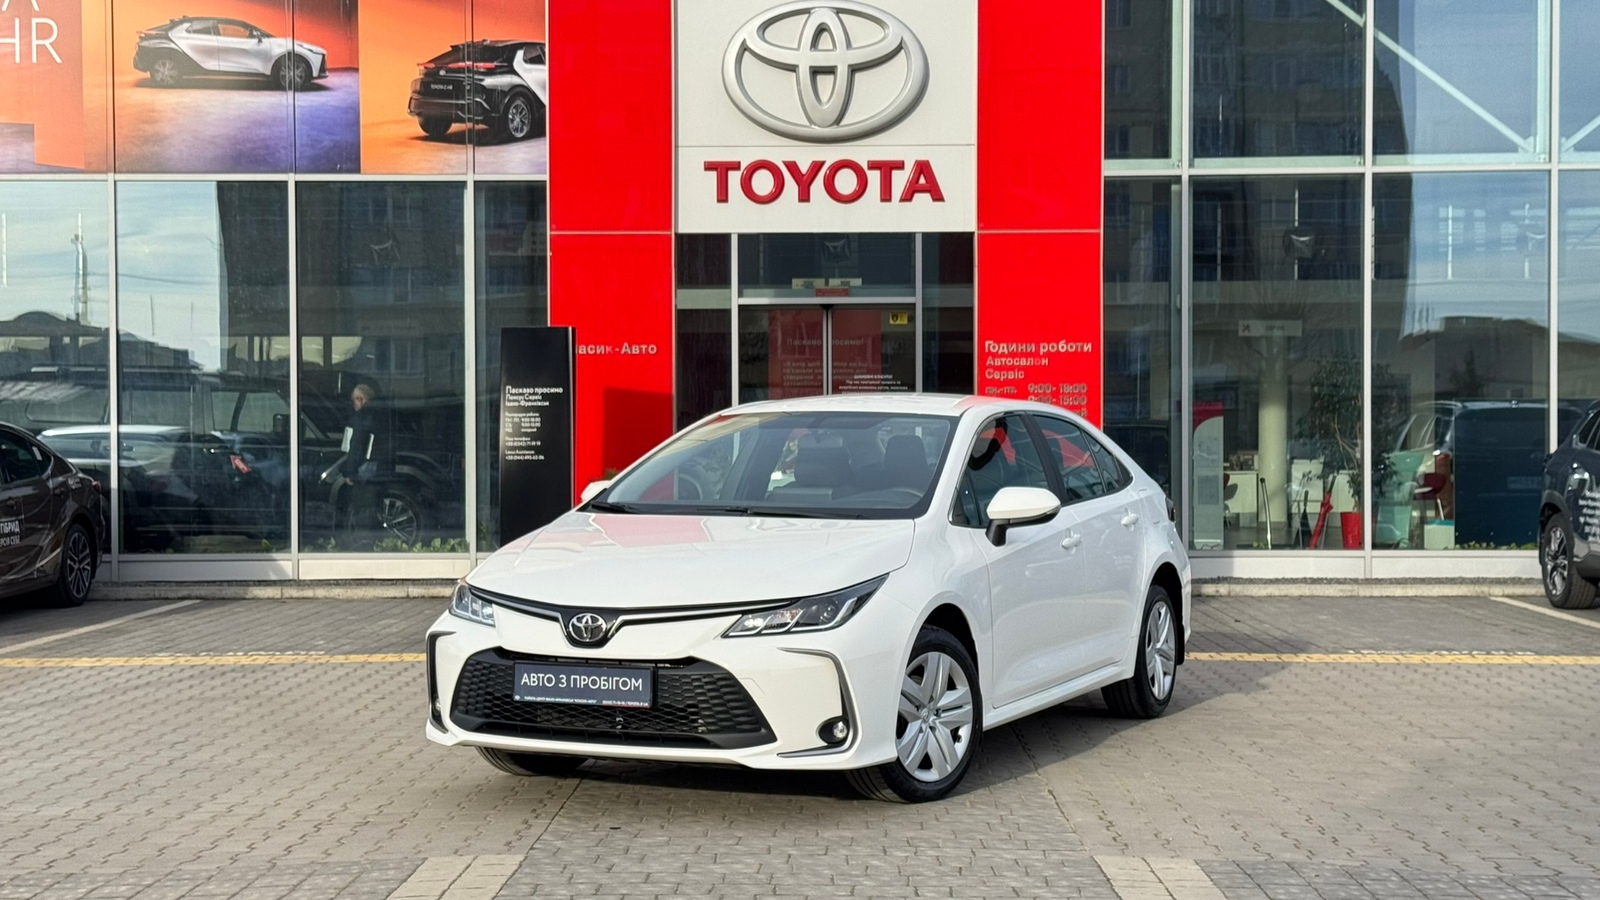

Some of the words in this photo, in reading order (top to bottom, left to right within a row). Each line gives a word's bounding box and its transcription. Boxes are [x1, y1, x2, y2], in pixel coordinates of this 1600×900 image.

[704, 159, 946, 205] TOYOTA
[832, 338, 864, 346] осимо!
[985, 340, 1035, 354] Години
[1040, 340, 1092, 355] роботи
[577, 342, 657, 355] асик-Авто
[986, 357, 1049, 367] Автосалон
[985, 369, 1025, 381] Сервіс
[506, 386, 534, 394] Ласкаво
[535, 387, 563, 395] просимо
[521, 673, 555, 687] АВТО
[559, 675, 567, 687] З
[570, 675, 643, 691] ПРОБІГОМ
